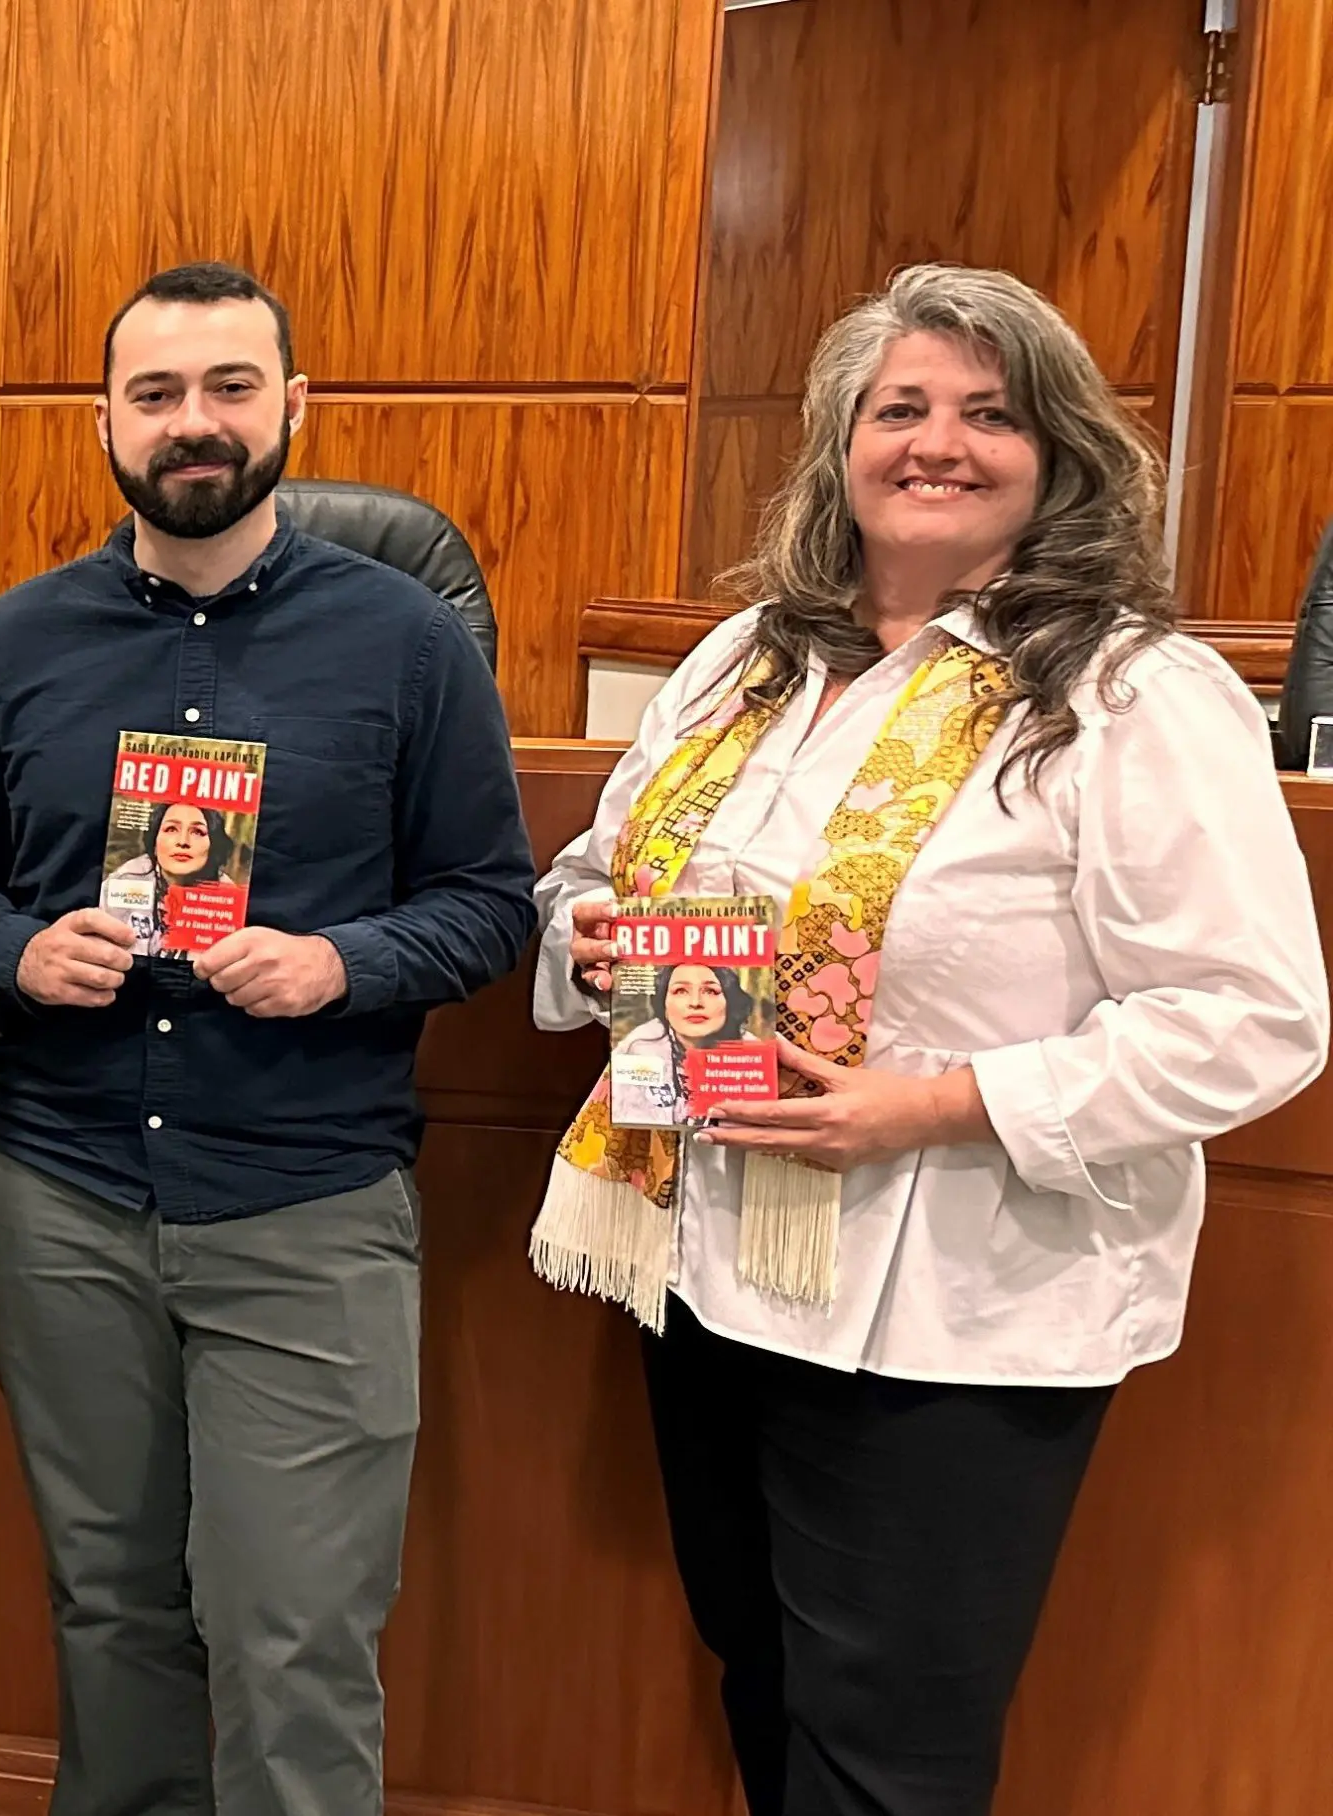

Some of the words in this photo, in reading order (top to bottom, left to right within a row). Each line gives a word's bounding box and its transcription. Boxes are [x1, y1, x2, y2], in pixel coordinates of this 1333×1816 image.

[119, 761, 170, 792] RED
[180, 767, 257, 803] PAINT
[617, 926, 669, 955] RED
[685, 926, 768, 956] PAINT
